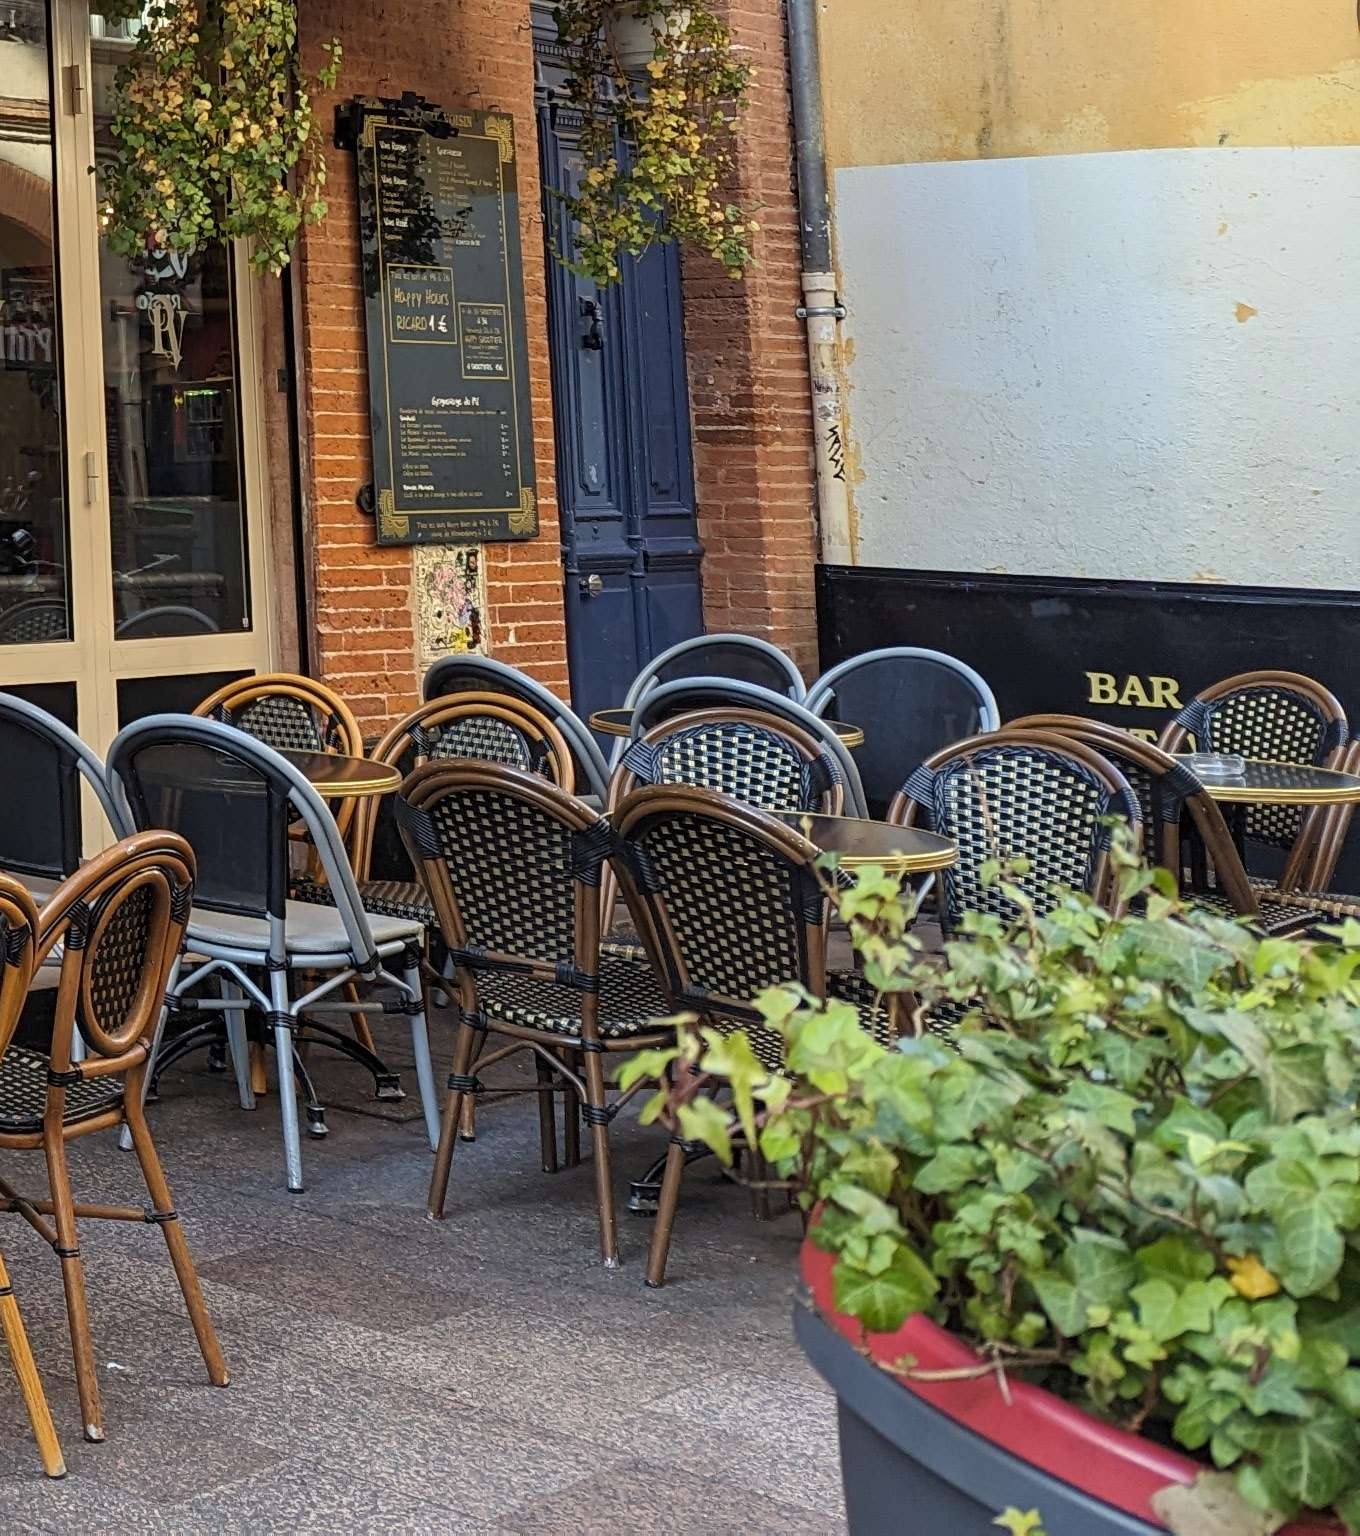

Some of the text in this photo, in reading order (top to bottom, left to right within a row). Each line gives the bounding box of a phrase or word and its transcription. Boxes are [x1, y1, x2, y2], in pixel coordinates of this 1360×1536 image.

[394, 288, 449, 308] Happy Hours
[397, 315, 427, 331] RICARD
[1086, 672, 1184, 710] BAR
